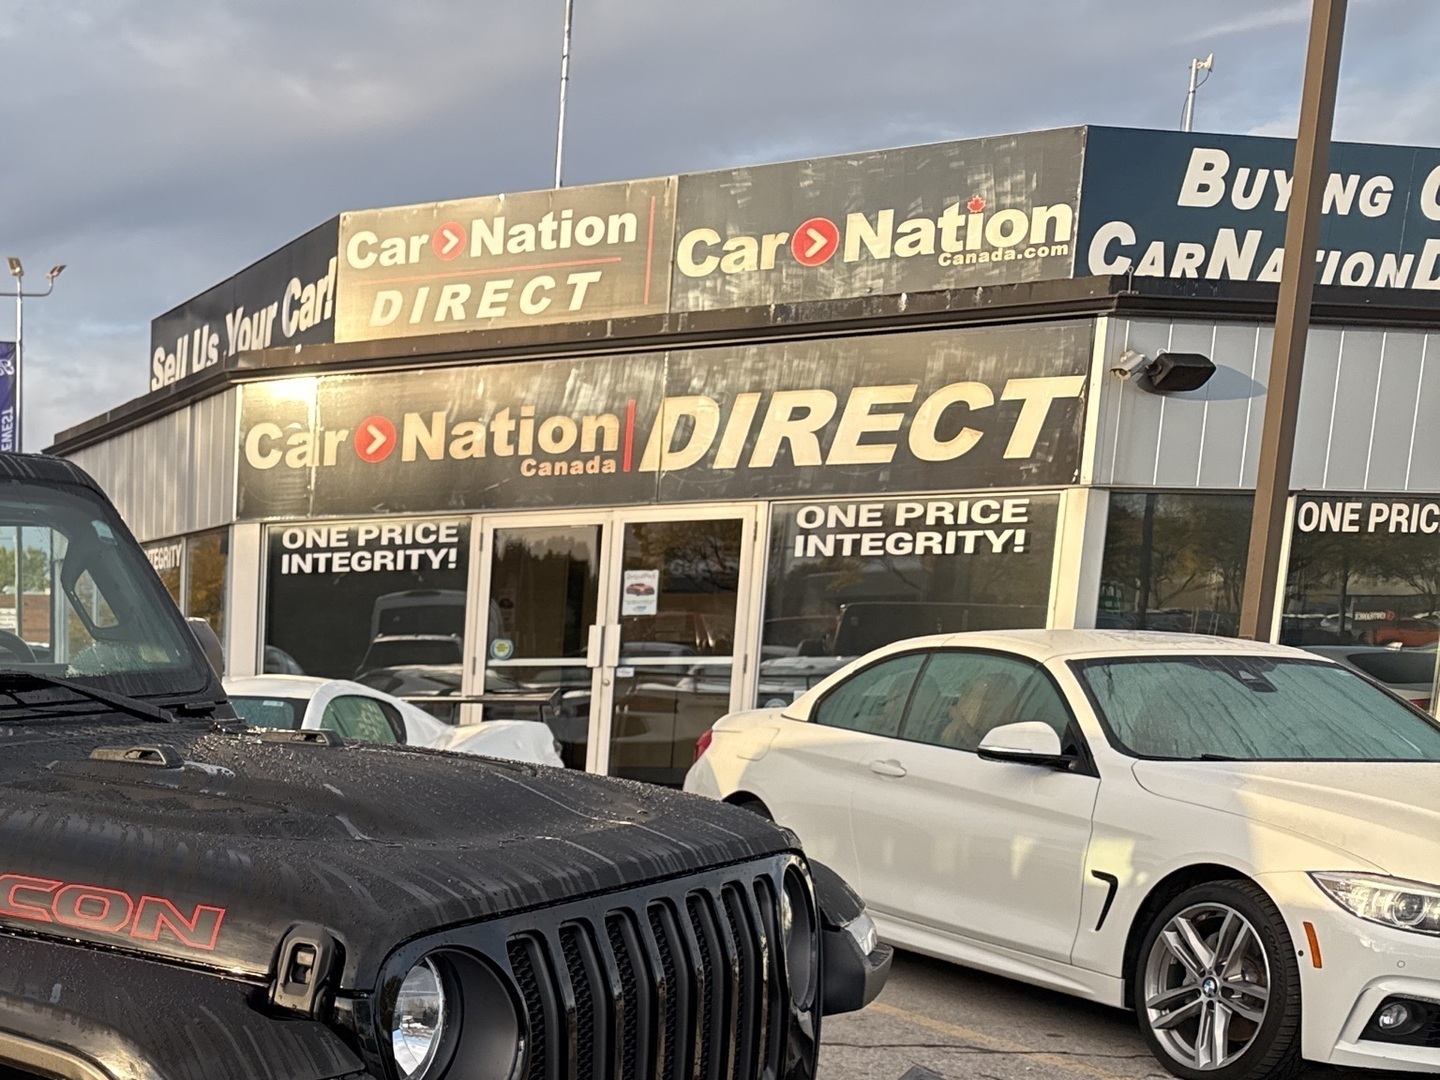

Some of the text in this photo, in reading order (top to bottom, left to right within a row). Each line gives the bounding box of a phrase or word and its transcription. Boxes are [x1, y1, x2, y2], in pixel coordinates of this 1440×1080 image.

[1177, 147, 1394, 218] BUYNG
[346, 209, 638, 269] Car Nation
[676, 201, 1073, 277] Car Nation
[938, 243, 1069, 267] Canada.com
[369, 271, 602, 327] DIRECT
[151, 256, 337, 392] Sell Us Your Car!
[245, 375, 1087, 472] Car Nation DIRECT
[520, 455, 616, 477] Canada
[796, 498, 1030, 530] ONE PRICE
[1297, 501, 1440, 534] ONE PRIC
[282, 522, 459, 550] ONE PRICE
[793, 529, 1026, 558] INTEGRITY!
[281, 548, 457, 575] INTEGRITY!
